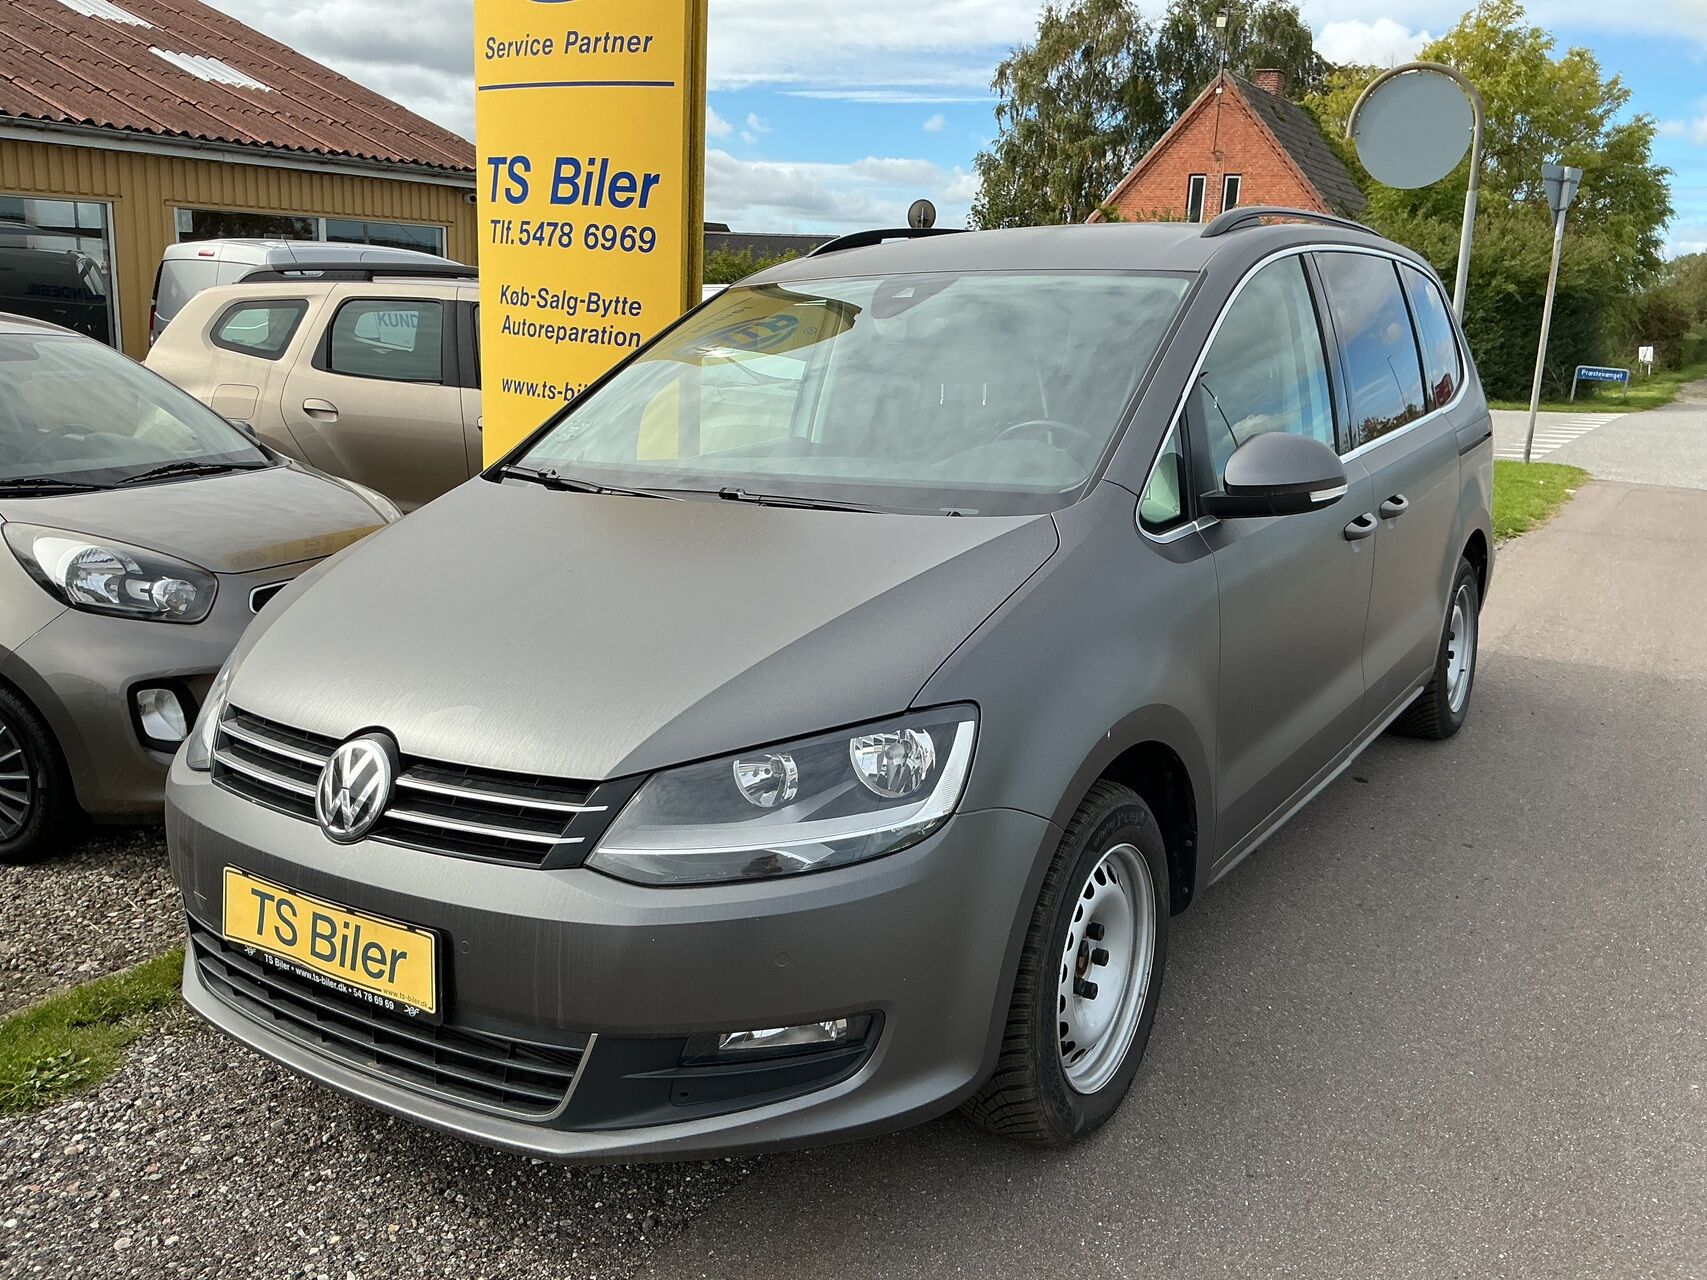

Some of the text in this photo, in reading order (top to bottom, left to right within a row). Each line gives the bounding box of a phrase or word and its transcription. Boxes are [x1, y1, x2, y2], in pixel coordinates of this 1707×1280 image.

[485, 30, 653, 60] Service Partner
[487, 155, 661, 209] TS Biler
[583, 223, 657, 253] 6969
[500, 284, 642, 318] Køb-Salg-Bytte
[501, 314, 642, 348] Autoreparation
[502, 378, 588, 401] www.ts-bi
[250, 887, 407, 984] TS Biler
[264, 953, 395, 1010] TS Biler www.ts-biler.dk 54 78 69 69
